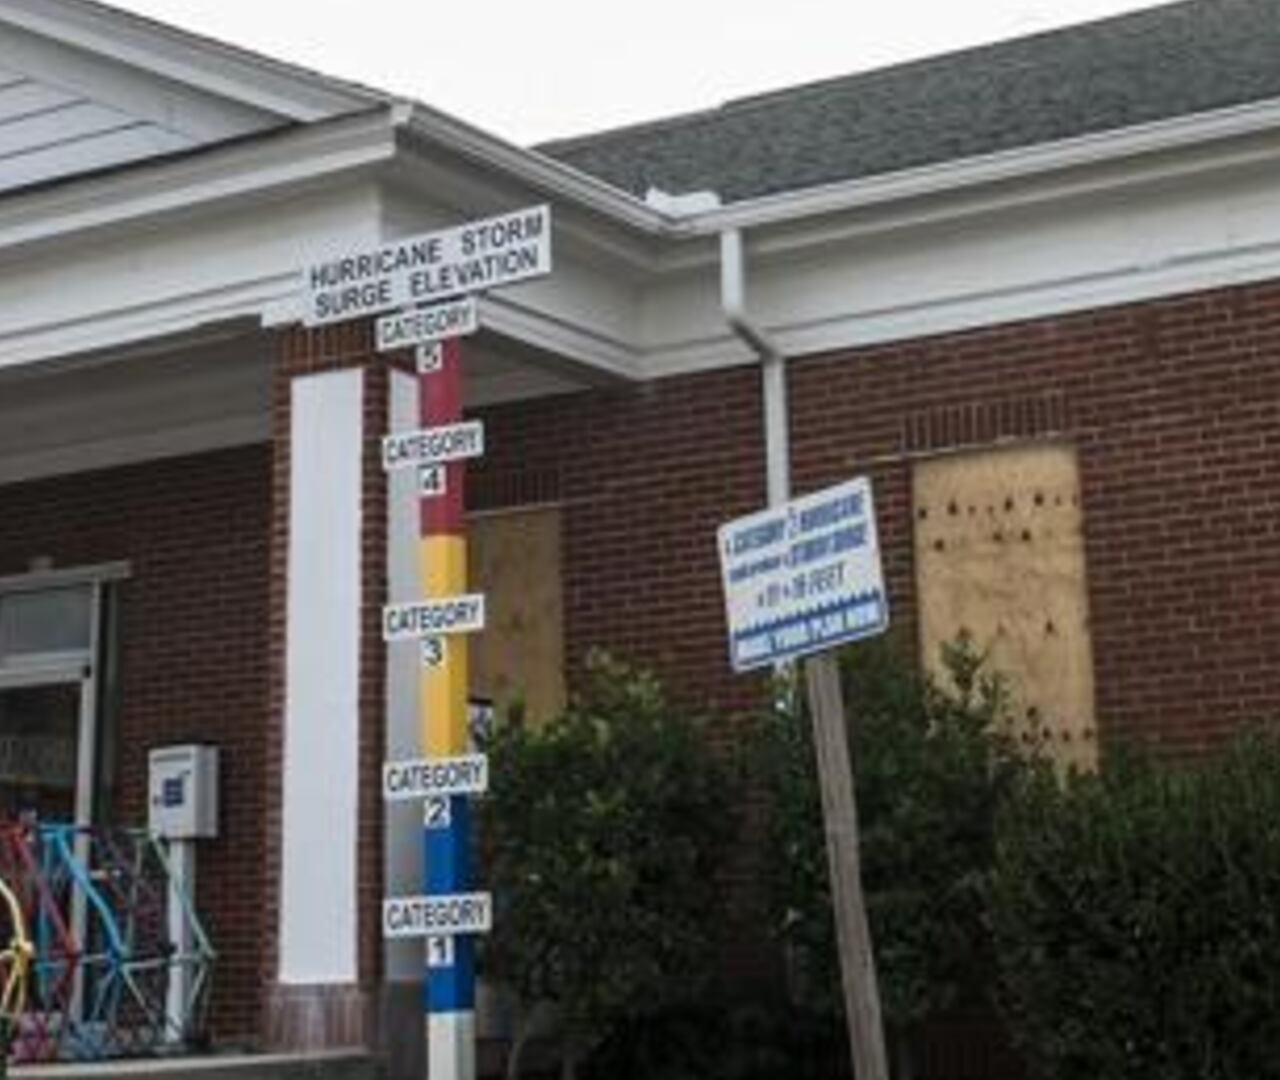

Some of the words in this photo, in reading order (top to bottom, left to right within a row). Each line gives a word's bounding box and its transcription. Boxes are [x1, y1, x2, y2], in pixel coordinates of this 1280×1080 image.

[311, 238, 443, 289] HURRICANE
[461, 212, 543, 257] STORM
[315, 280, 392, 319] SURGE
[409, 244, 539, 297] ELEVATION
[382, 307, 471, 343] CATEGORY
[386, 429, 479, 463] CATEGORY
[422, 467, 440, 492] 4
[386, 601, 480, 633] CATEGORY
[424, 638, 443, 667] 3
[386, 760, 484, 792] CATEGORY
[428, 795, 447, 824] 2
[386, 900, 486, 930] CATEGORY
[433, 939, 447, 964] 1
